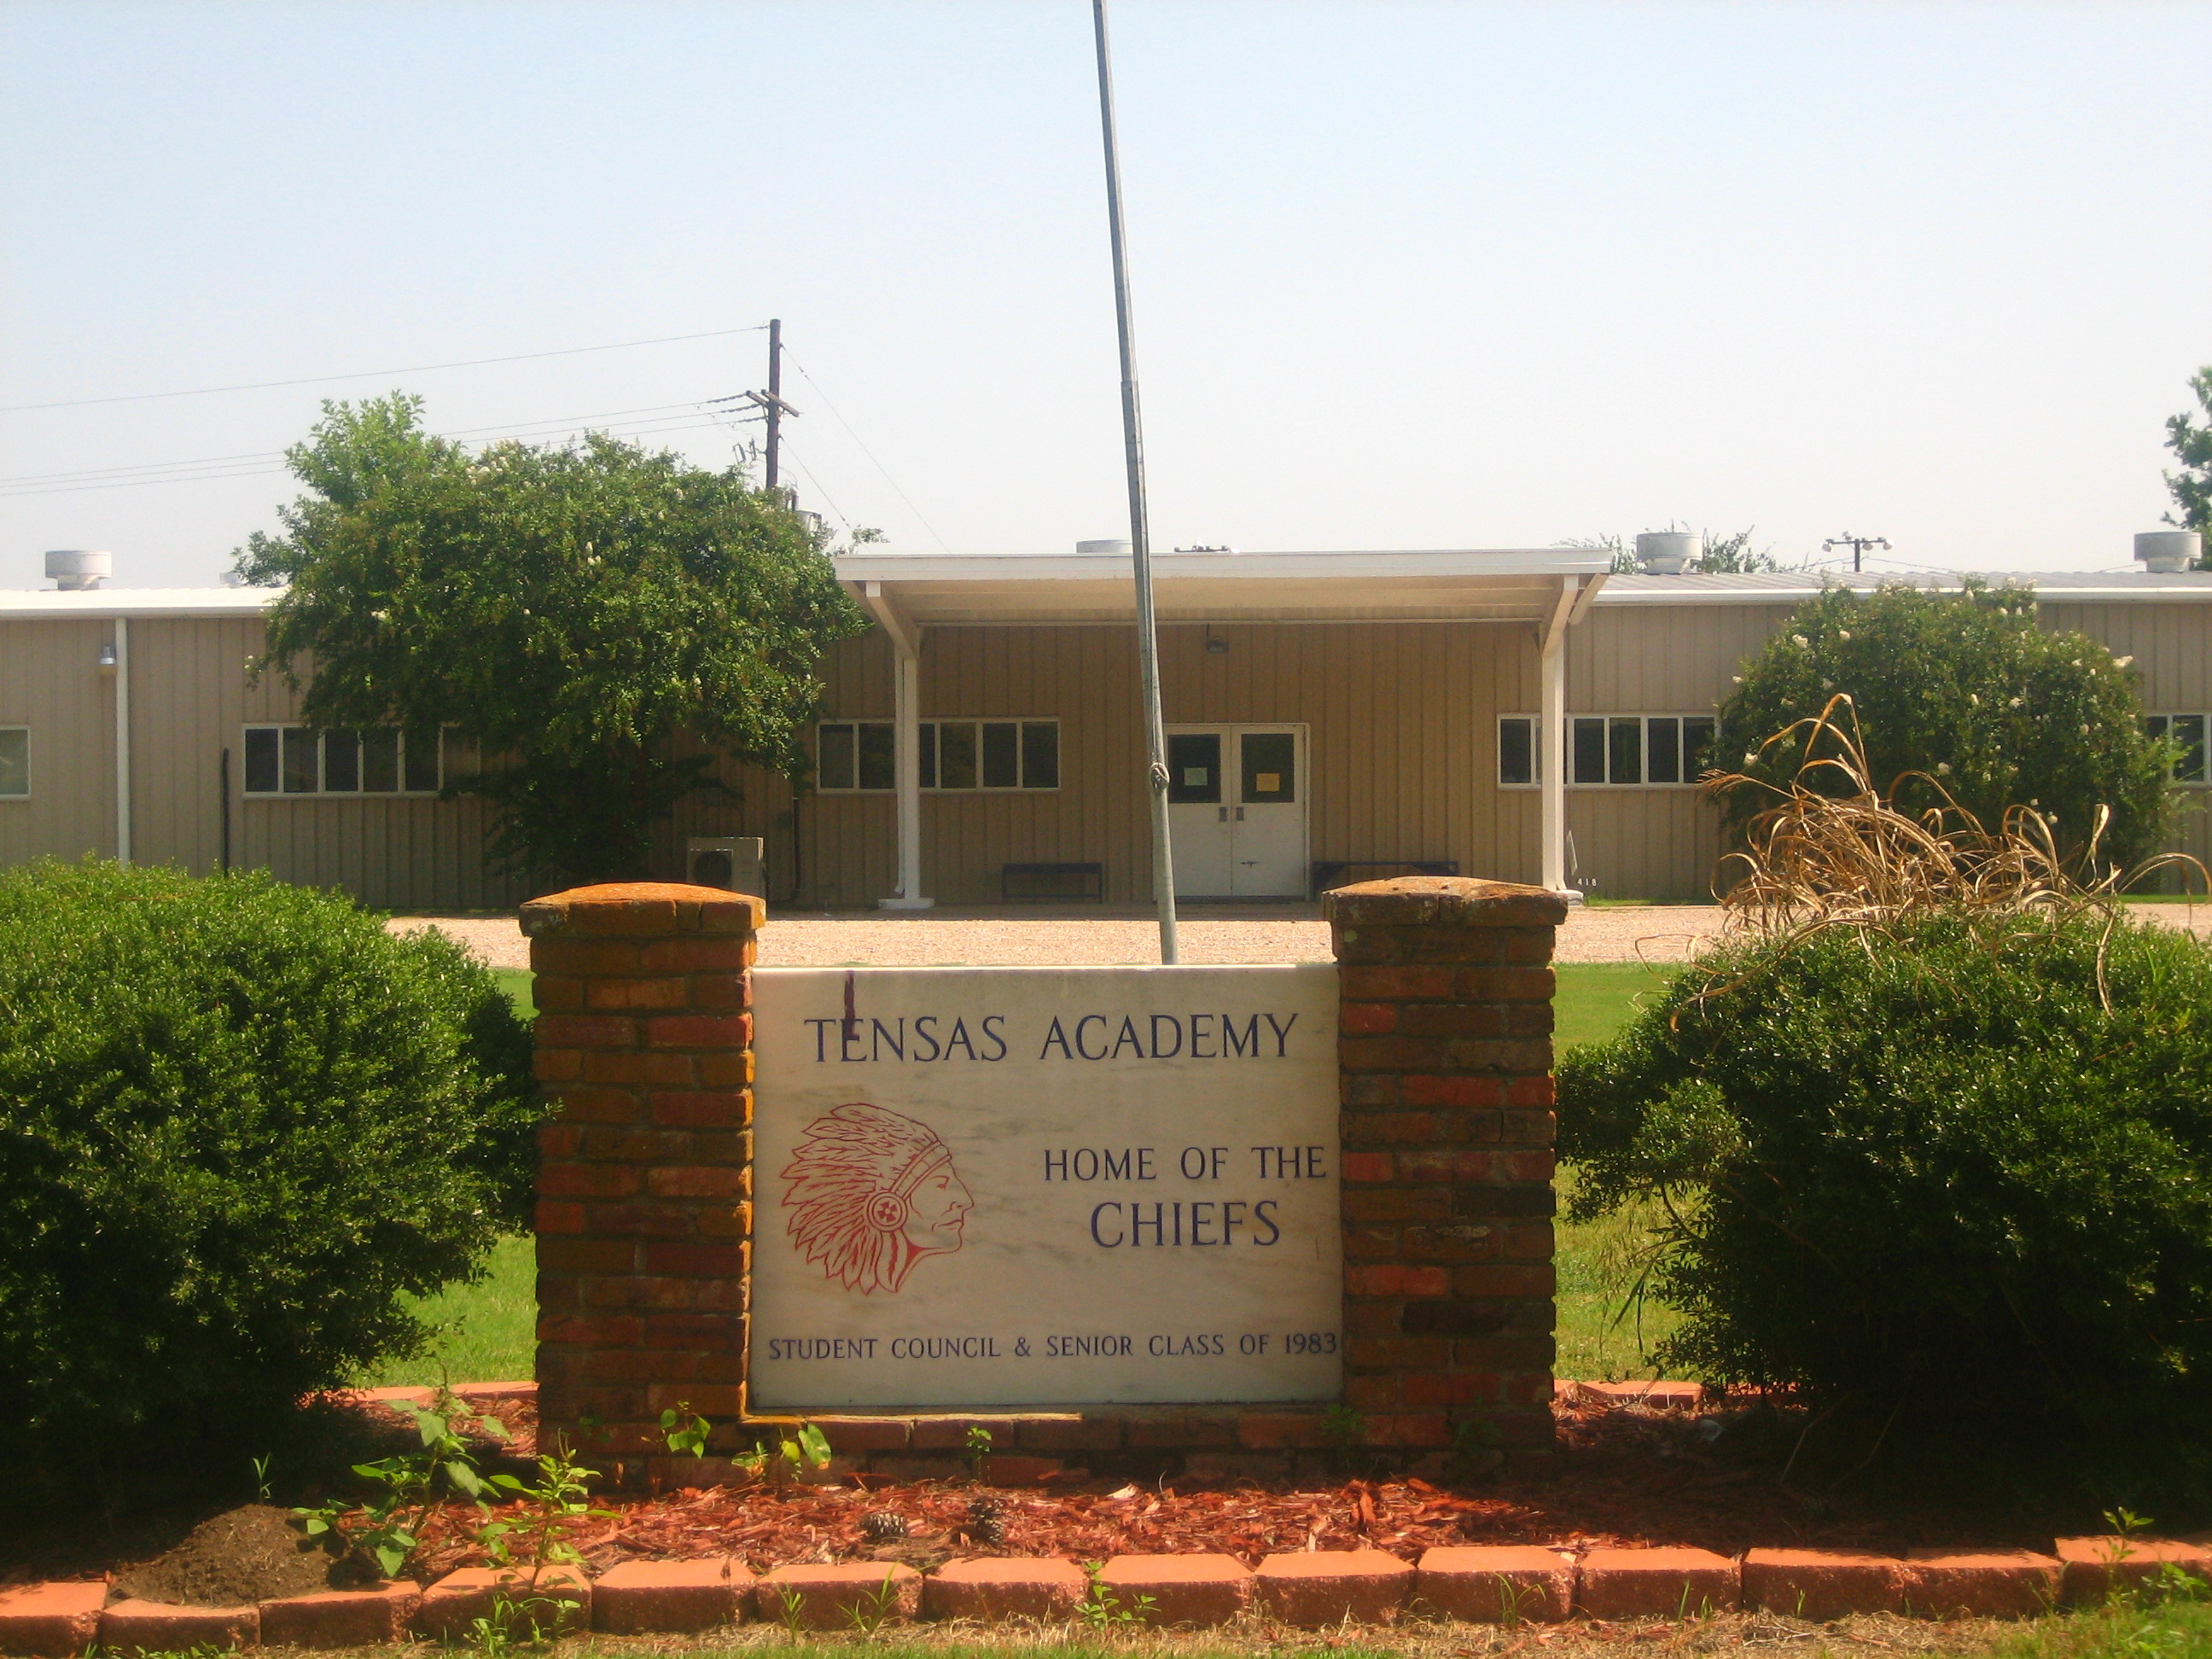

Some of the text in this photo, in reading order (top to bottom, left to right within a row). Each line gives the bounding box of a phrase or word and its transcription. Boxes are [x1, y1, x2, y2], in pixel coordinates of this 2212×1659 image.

[804, 1011, 1300, 1063] TENSAS ACADEMY
[1042, 1144, 1327, 1182] HOME OF THE
[1089, 1198, 1282, 1249] CHIEFS
[768, 1331, 1338, 1359] STUDENT COUNCIL & SENIOR CLASS OF 1983
